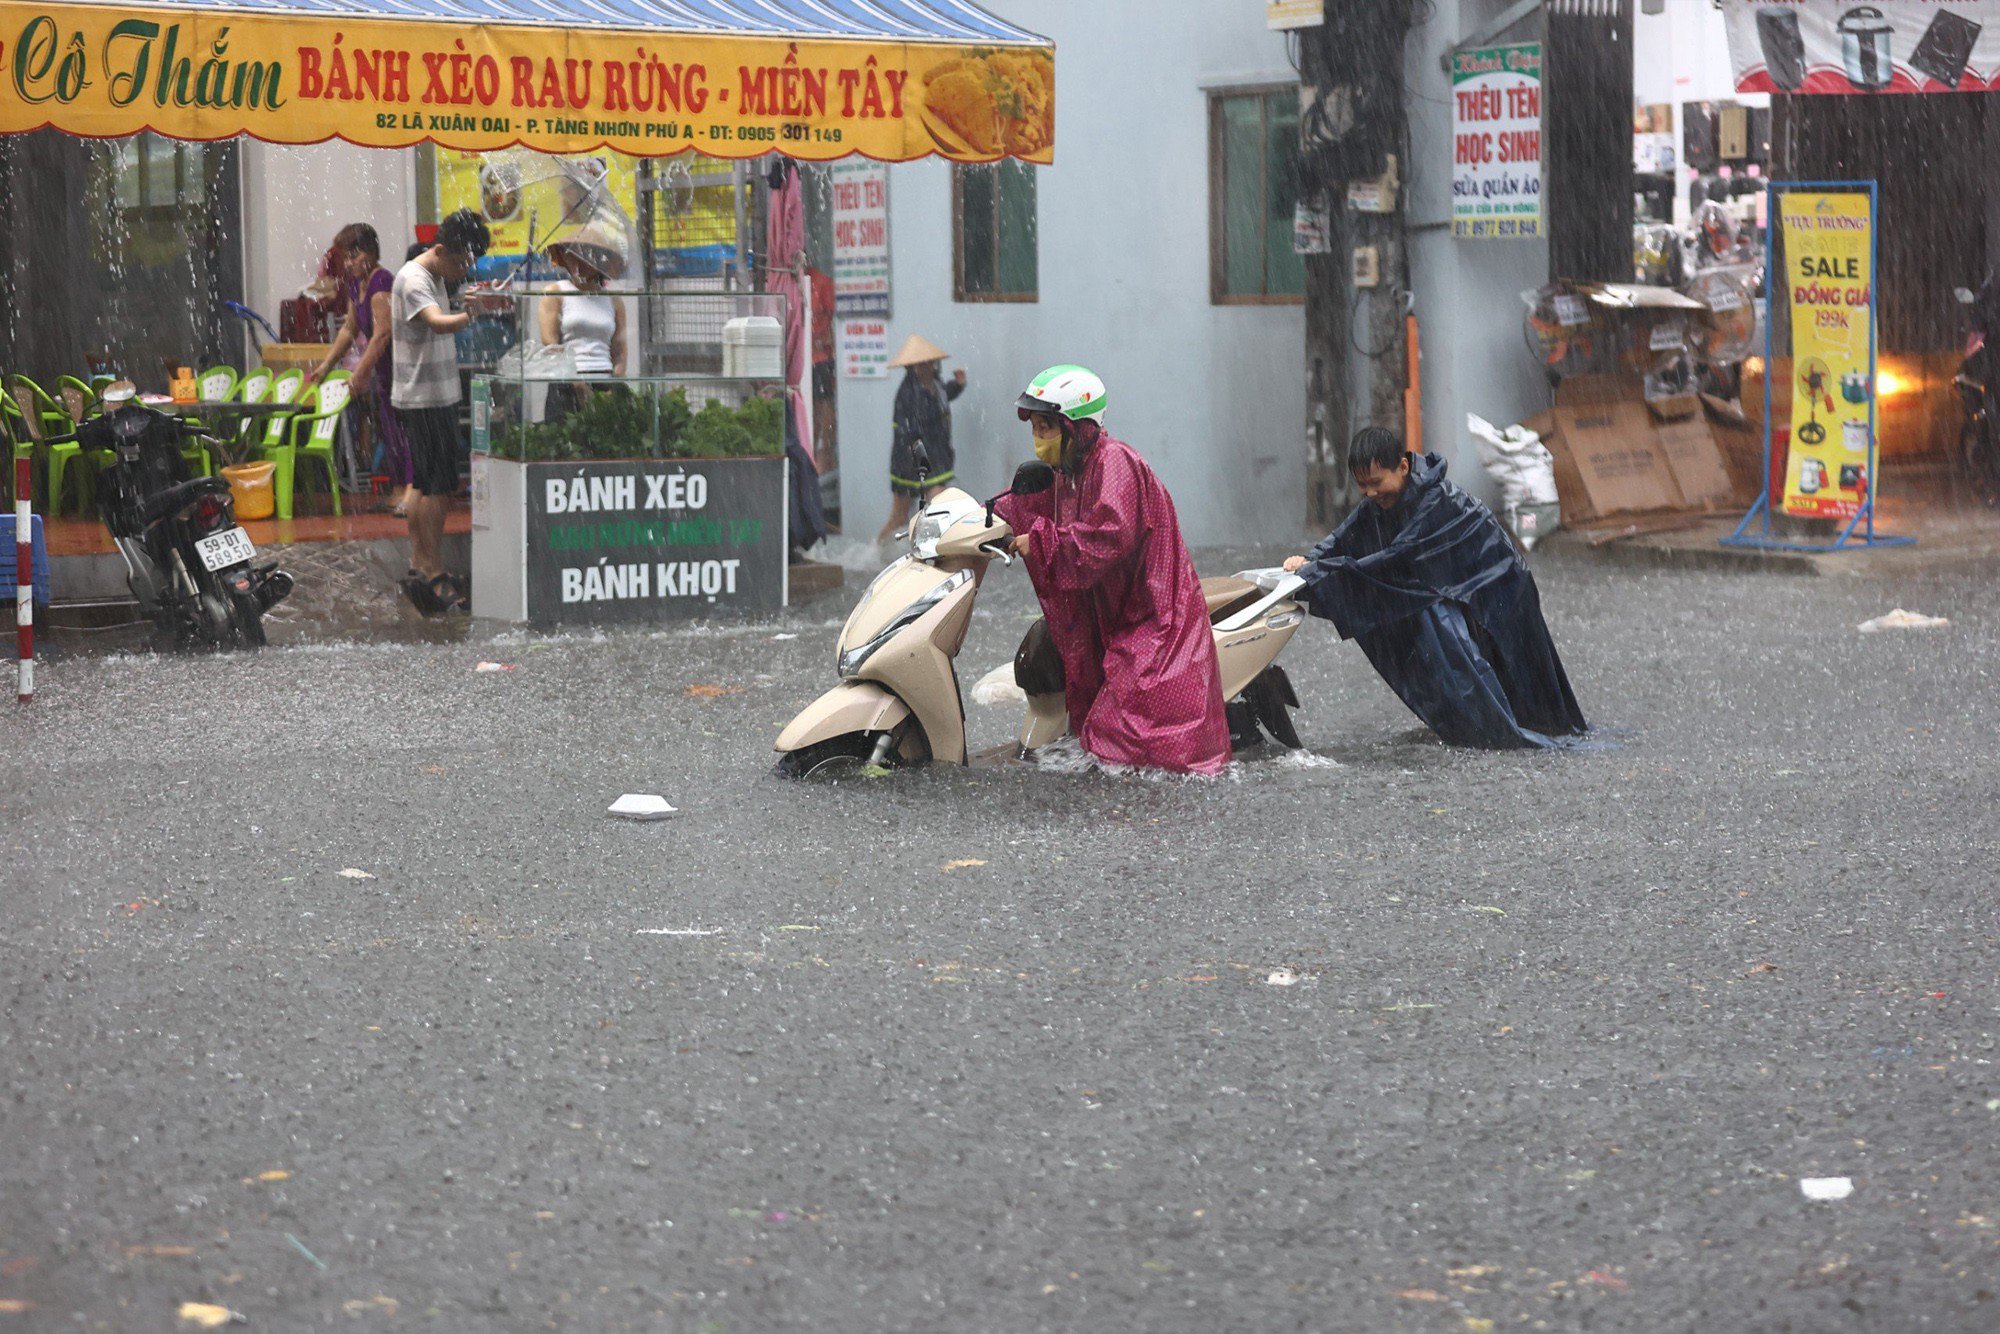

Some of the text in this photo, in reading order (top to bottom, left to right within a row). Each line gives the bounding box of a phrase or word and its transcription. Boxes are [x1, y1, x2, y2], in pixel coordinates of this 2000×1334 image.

[12, 15, 287, 111] Cô Thắm
[298, 32, 908, 118] BÁNH XÈO RAU RỪNG MIỀN TÂY
[1456, 80, 1540, 122] THÊU TÊN
[376, 114, 397, 129] 82
[403, 112, 423, 130] LÃ
[429, 113, 476, 131] XUÂN
[482, 117, 510, 133] OAI
[527, 119, 540, 134] P.
[545, 117, 588, 135] TĂNG
[594, 120, 640, 137] NHƠN
[683, 125, 694, 138] A
[710, 125, 733, 139] ĐT:
[737, 126, 775, 141] 0905
[783, 124, 810, 141] 301
[815, 129, 842, 142] 149
[1456, 130, 1540, 171] HỌC SINH
[1453, 173, 1479, 196] SỬA
[1801, 256, 1859, 278] SALE
[546, 466, 707, 513] BÁNH XÈO
[204, 532, 240, 553] 59-D1
[206, 543, 251, 568] 589.50
[562, 556, 741, 603] BÁNH KHỌT
